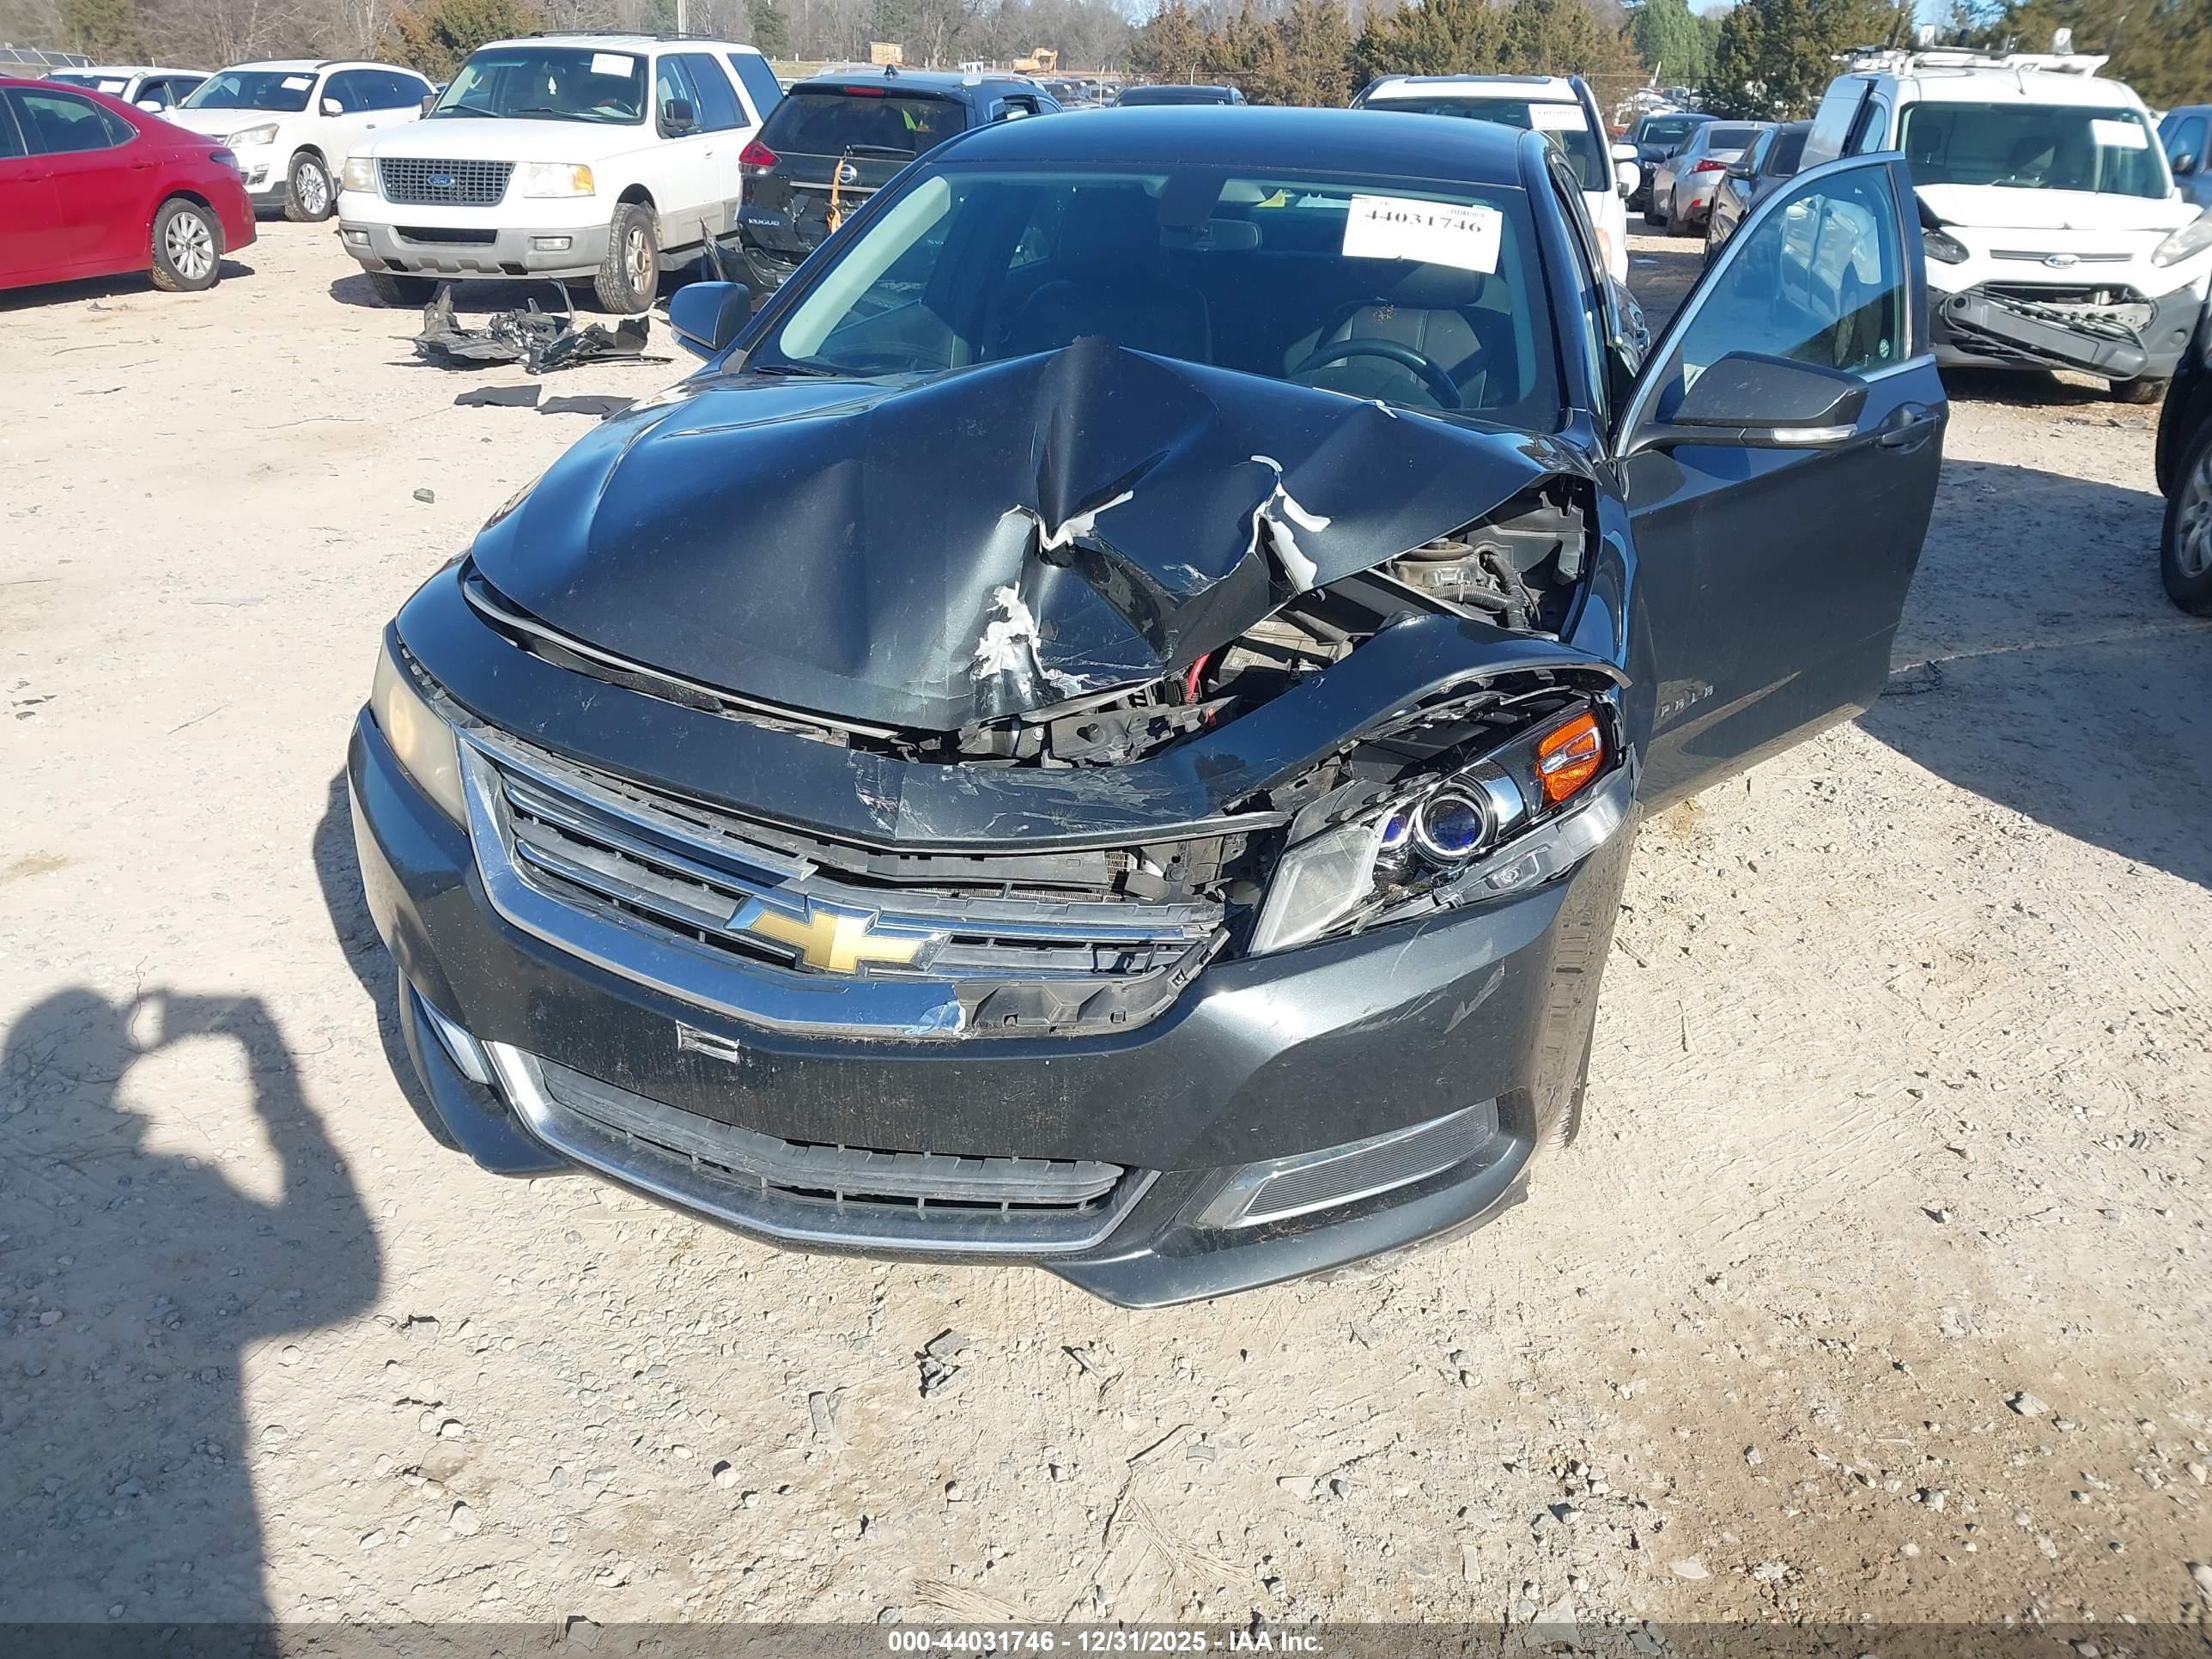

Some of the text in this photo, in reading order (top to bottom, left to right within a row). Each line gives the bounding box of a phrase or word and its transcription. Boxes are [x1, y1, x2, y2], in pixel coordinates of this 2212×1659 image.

[748, 218, 781, 227] ROGUE
[1364, 210, 1482, 233] 44031746
[1661, 684, 1715, 718] PALA
